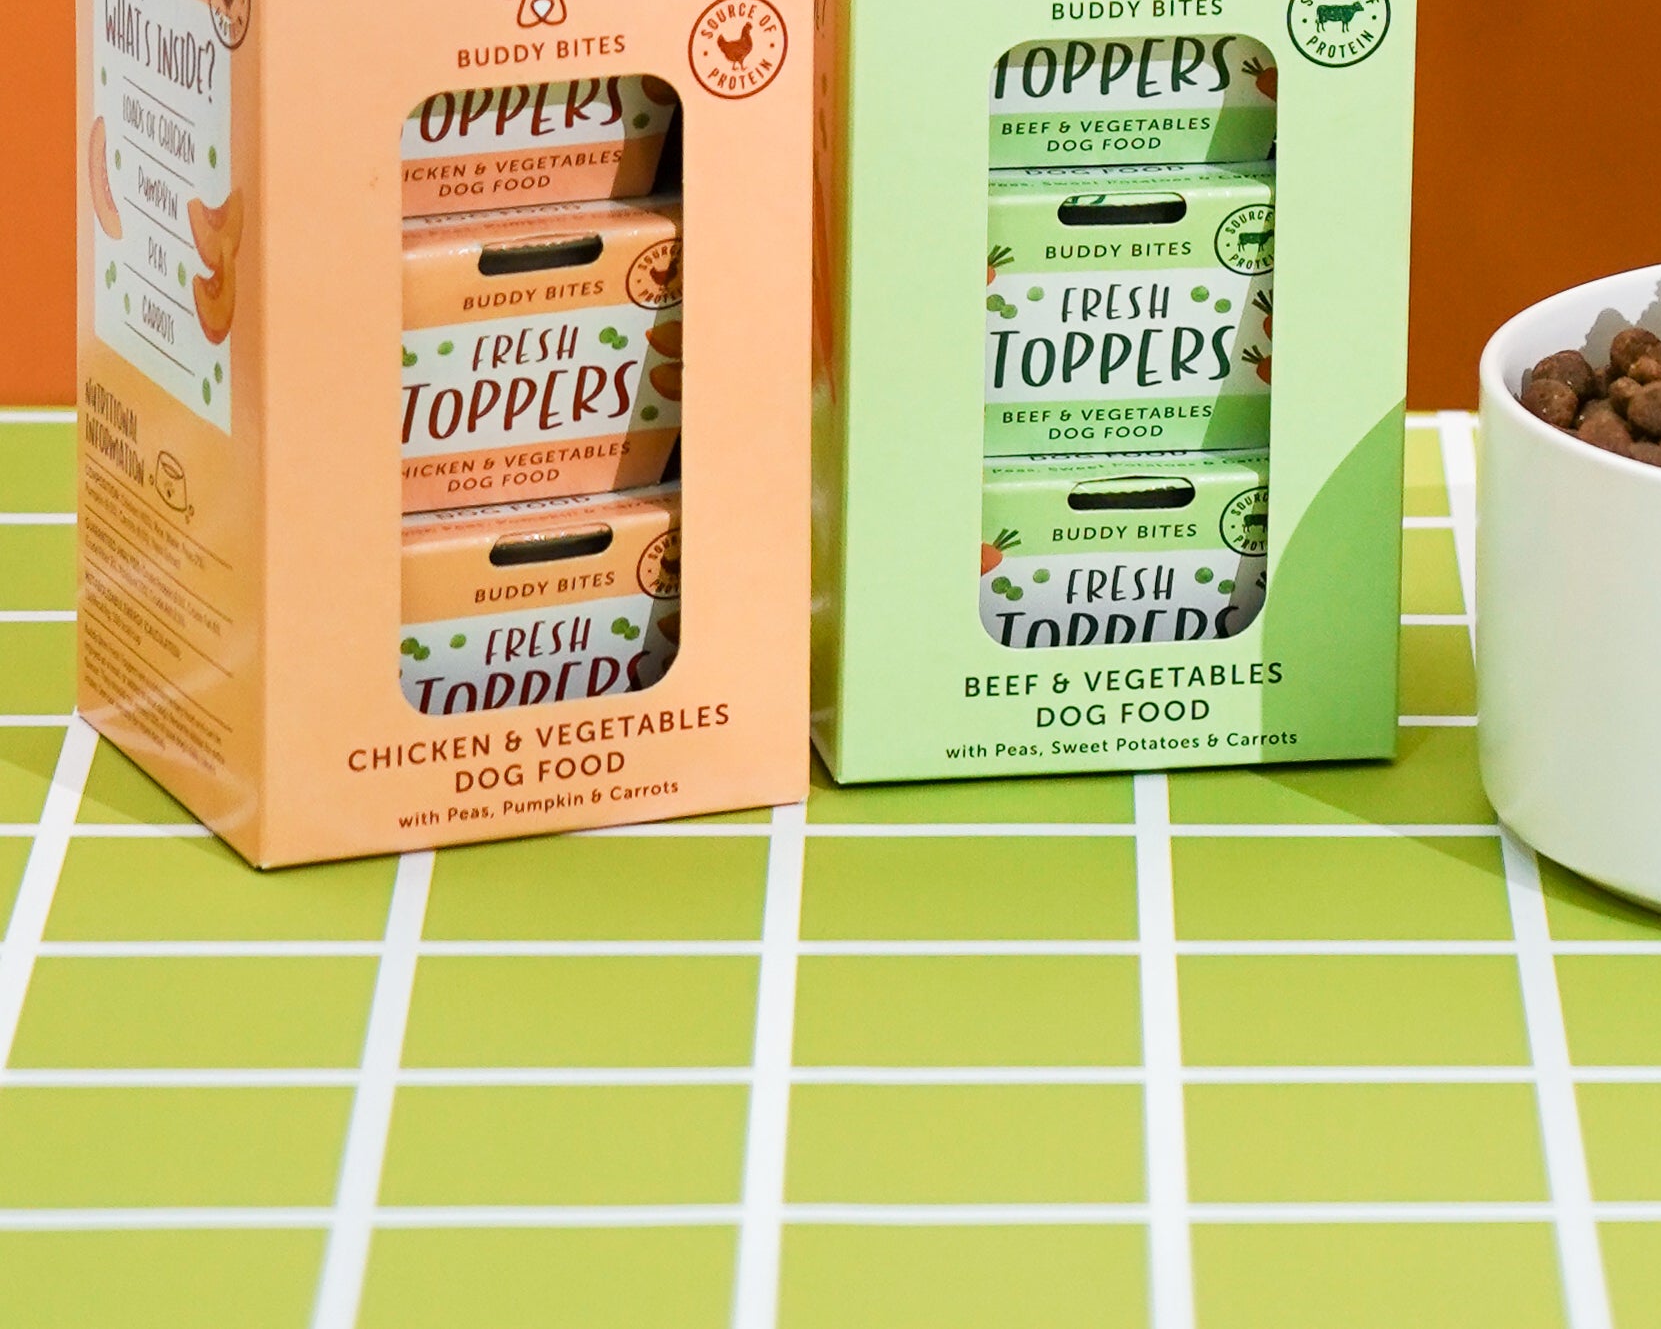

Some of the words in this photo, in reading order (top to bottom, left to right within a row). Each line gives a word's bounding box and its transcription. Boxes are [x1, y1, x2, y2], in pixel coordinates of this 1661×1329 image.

[701, 2, 757, 39] SOURCE
[759, 14, 777, 32] OF
[1051, 0, 1139, 21] BUDDY
[457, 42, 545, 69] BUDDY
[557, 35, 626, 59] BITES
[1306, 29, 1374, 58] PROTEIN
[156, 23, 216, 104] INSIDE?
[707, 58, 773, 90] PROTEIN
[401, 75, 625, 143] OPPERS
[1001, 121, 1050, 136] BEEF
[1058, 120, 1071, 133] &
[1080, 116, 1211, 133] VEGETABLES
[158, 114, 195, 165] CHICKEN
[1047, 138, 1094, 153] DOG
[1102, 136, 1162, 151] FOOD
[401, 163, 465, 183] ICKEN
[474, 159, 486, 176] &
[495, 149, 623, 174] VEGETABLES
[438, 180, 484, 198] DOG
[493, 175, 551, 193] FOOD
[1225, 210, 1273, 234] SOURCE
[148, 236, 167, 277] PEAS
[1045, 244, 1122, 259] BUDDY
[1131, 241, 1192, 257] BITES
[1229, 254, 1273, 269] PROTEI
[463, 289, 537, 311] BUDDY
[545, 280, 605, 300] BITES
[1062, 283, 1170, 323] FRESH
[471, 324, 579, 372] FRESH
[990, 325, 1235, 389] TOPPERS
[401, 360, 638, 444] TOPPERS
[1002, 410, 1052, 423] BEEF
[1060, 409, 1071, 421] &
[1081, 405, 1212, 421] VEGETABLES
[1049, 427, 1095, 440] DOG
[1104, 425, 1163, 439] FOOD
[401, 458, 475, 480] HICKEN
[483, 456, 495, 471] &
[504, 440, 631, 469] VEGETABLES
[447, 475, 493, 493] DOG
[502, 468, 561, 487] FOOD
[1052, 526, 1128, 542] BUDDY
[1137, 523, 1198, 539] BITES
[474, 581, 550, 604] BUDDY
[557, 571, 616, 593] BITES
[1067, 565, 1175, 604] FRESH
[485, 616, 592, 666] FRESH
[965, 674, 1038, 697] BEEF
[1052, 673, 1070, 693] &
[1084, 661, 1284, 692] VEGETABLES
[1036, 704, 1106, 728] DOG
[1121, 699, 1210, 724] FOOD
[348, 734, 491, 772] CHICKEN
[505, 730, 522, 753] &
[536, 703, 731, 749] VEGETABLES
[946, 744, 987, 759] with
[995, 742, 1043, 758] Peas,
[1051, 740, 1109, 755] Sweet
[1116, 735, 1200, 752] Potatoes
[1206, 733, 1218, 747] &
[1226, 731, 1298, 747] Carrots
[455, 764, 524, 794] DOG
[538, 751, 626, 783] FOOD
[399, 810, 440, 829] with
[448, 803, 495, 823] Peas,
[503, 792, 585, 816] Pumpkin
[591, 786, 602, 803] &
[610, 779, 679, 802] Carrots
